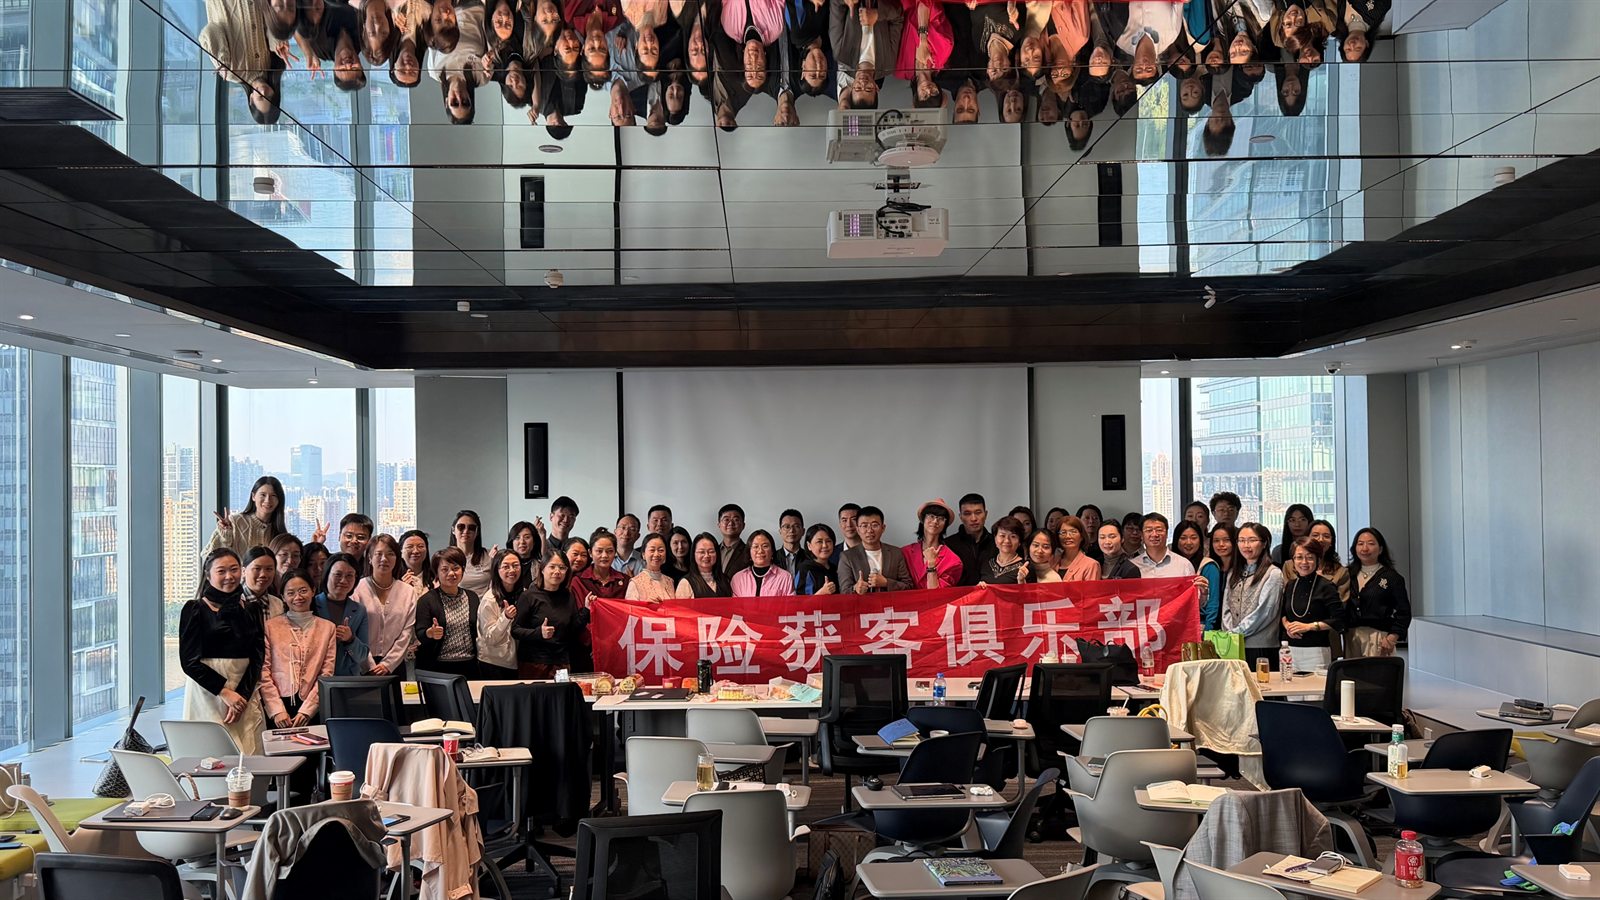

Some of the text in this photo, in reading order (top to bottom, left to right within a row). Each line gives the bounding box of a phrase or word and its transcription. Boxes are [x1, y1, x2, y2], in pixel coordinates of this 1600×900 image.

[618, 595, 1167, 675] 保险获客俱乐部
